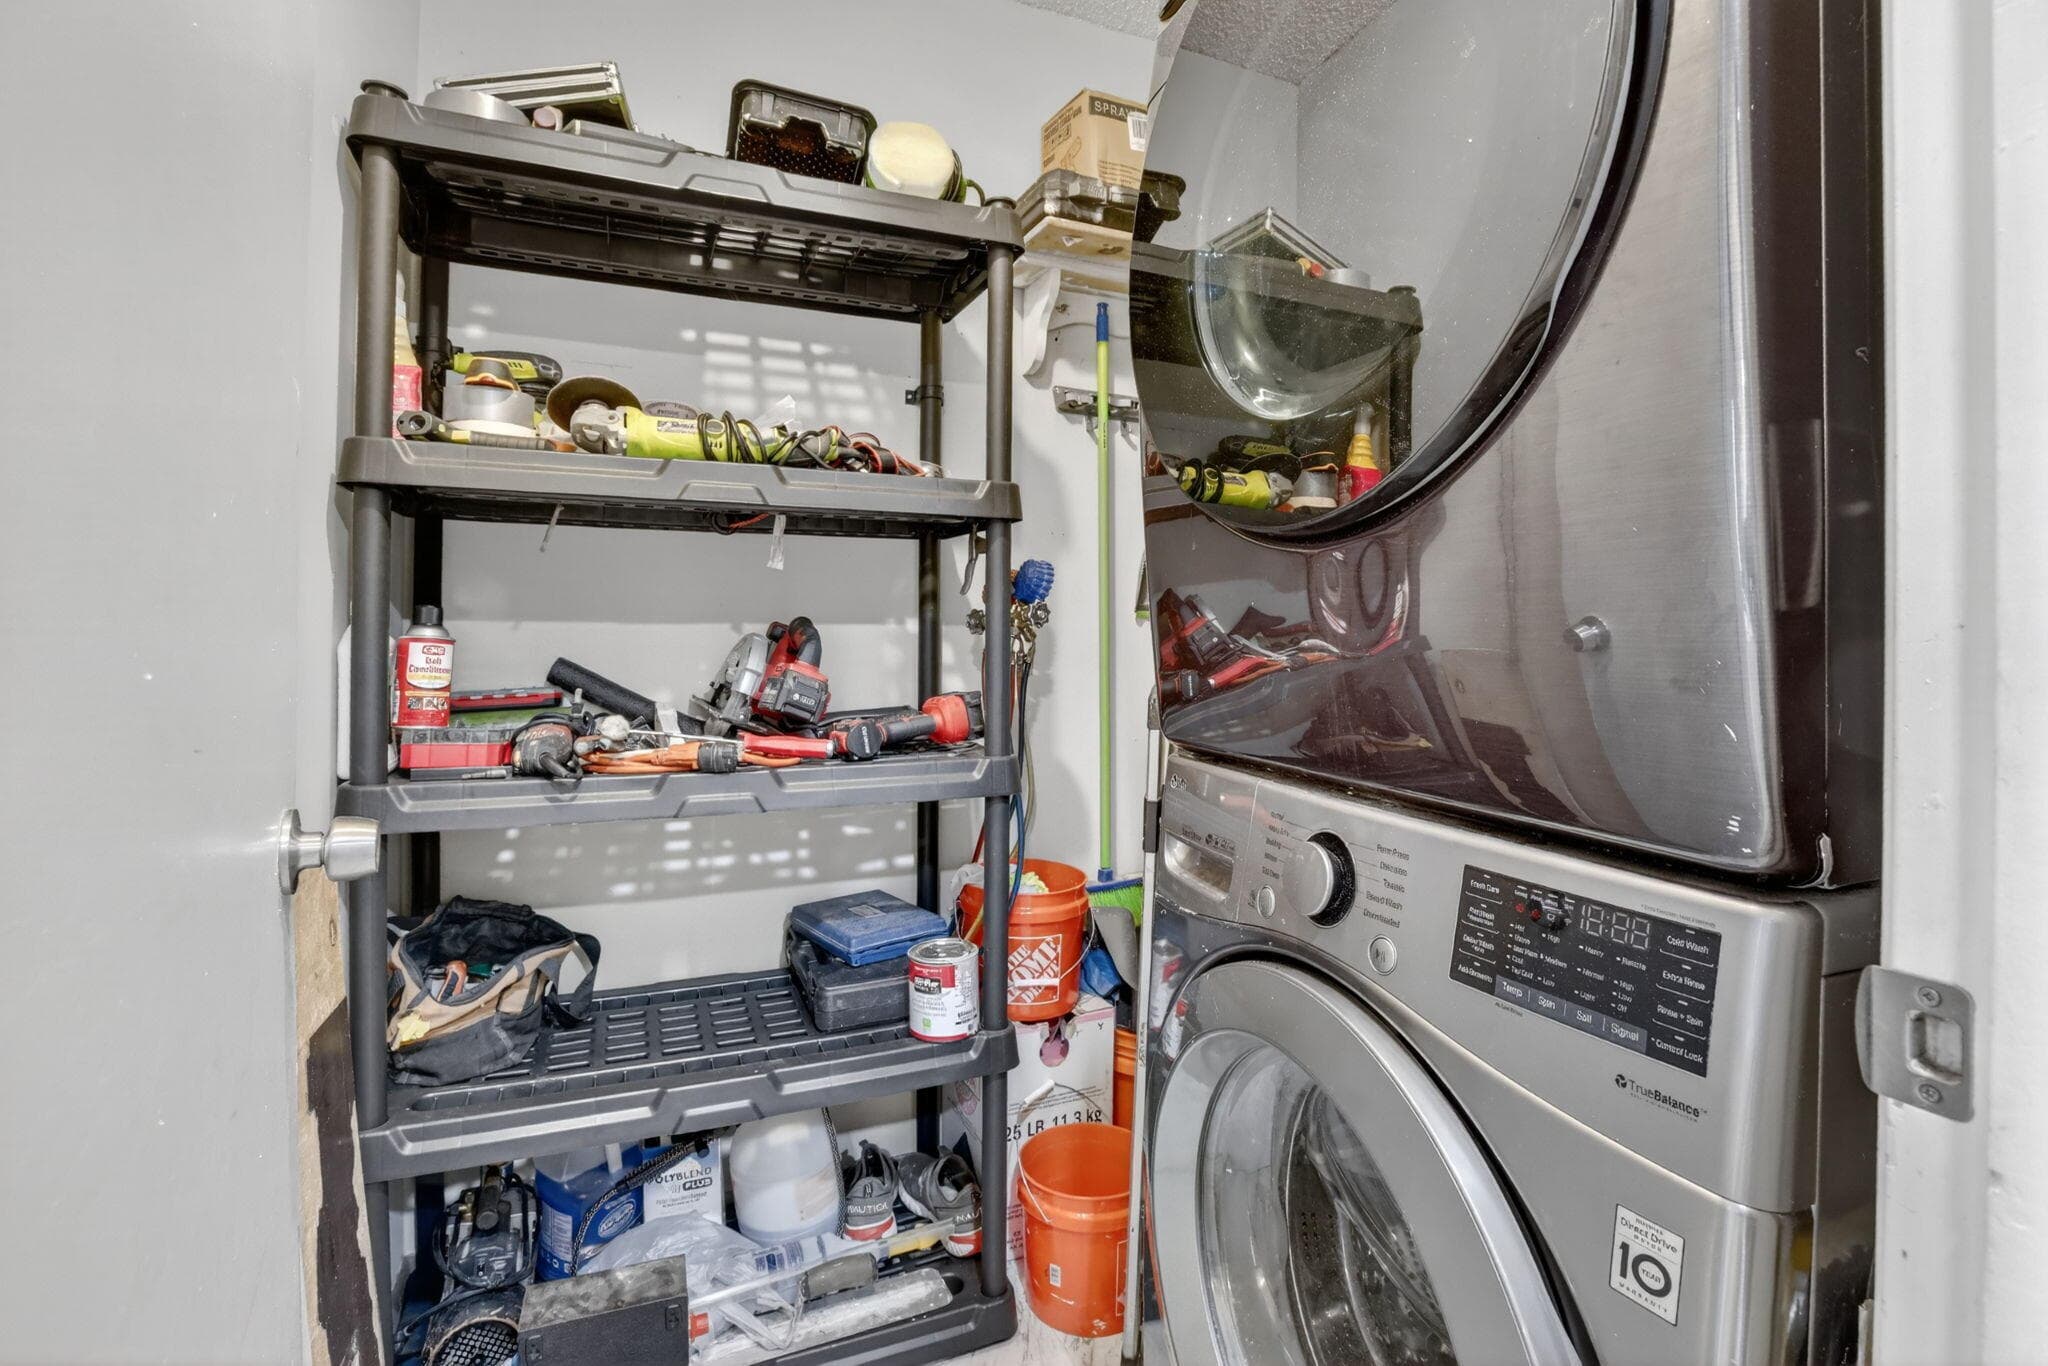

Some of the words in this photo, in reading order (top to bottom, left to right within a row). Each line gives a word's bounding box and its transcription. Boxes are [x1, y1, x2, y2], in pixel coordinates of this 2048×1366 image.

[1502, 981, 1523, 998] Temp
[1538, 996, 1556, 1010] Spin
[1611, 1022, 1640, 1042] Signal
[1628, 1078, 1700, 1118] TrueBalance
[847, 1201, 889, 1214] NAUTICA
[1620, 1216, 1649, 1239] Direct
[1650, 1232, 1678, 1253] Drive
[1619, 1240, 1672, 1298] 10
[1641, 1268, 1662, 1284] YEAR
